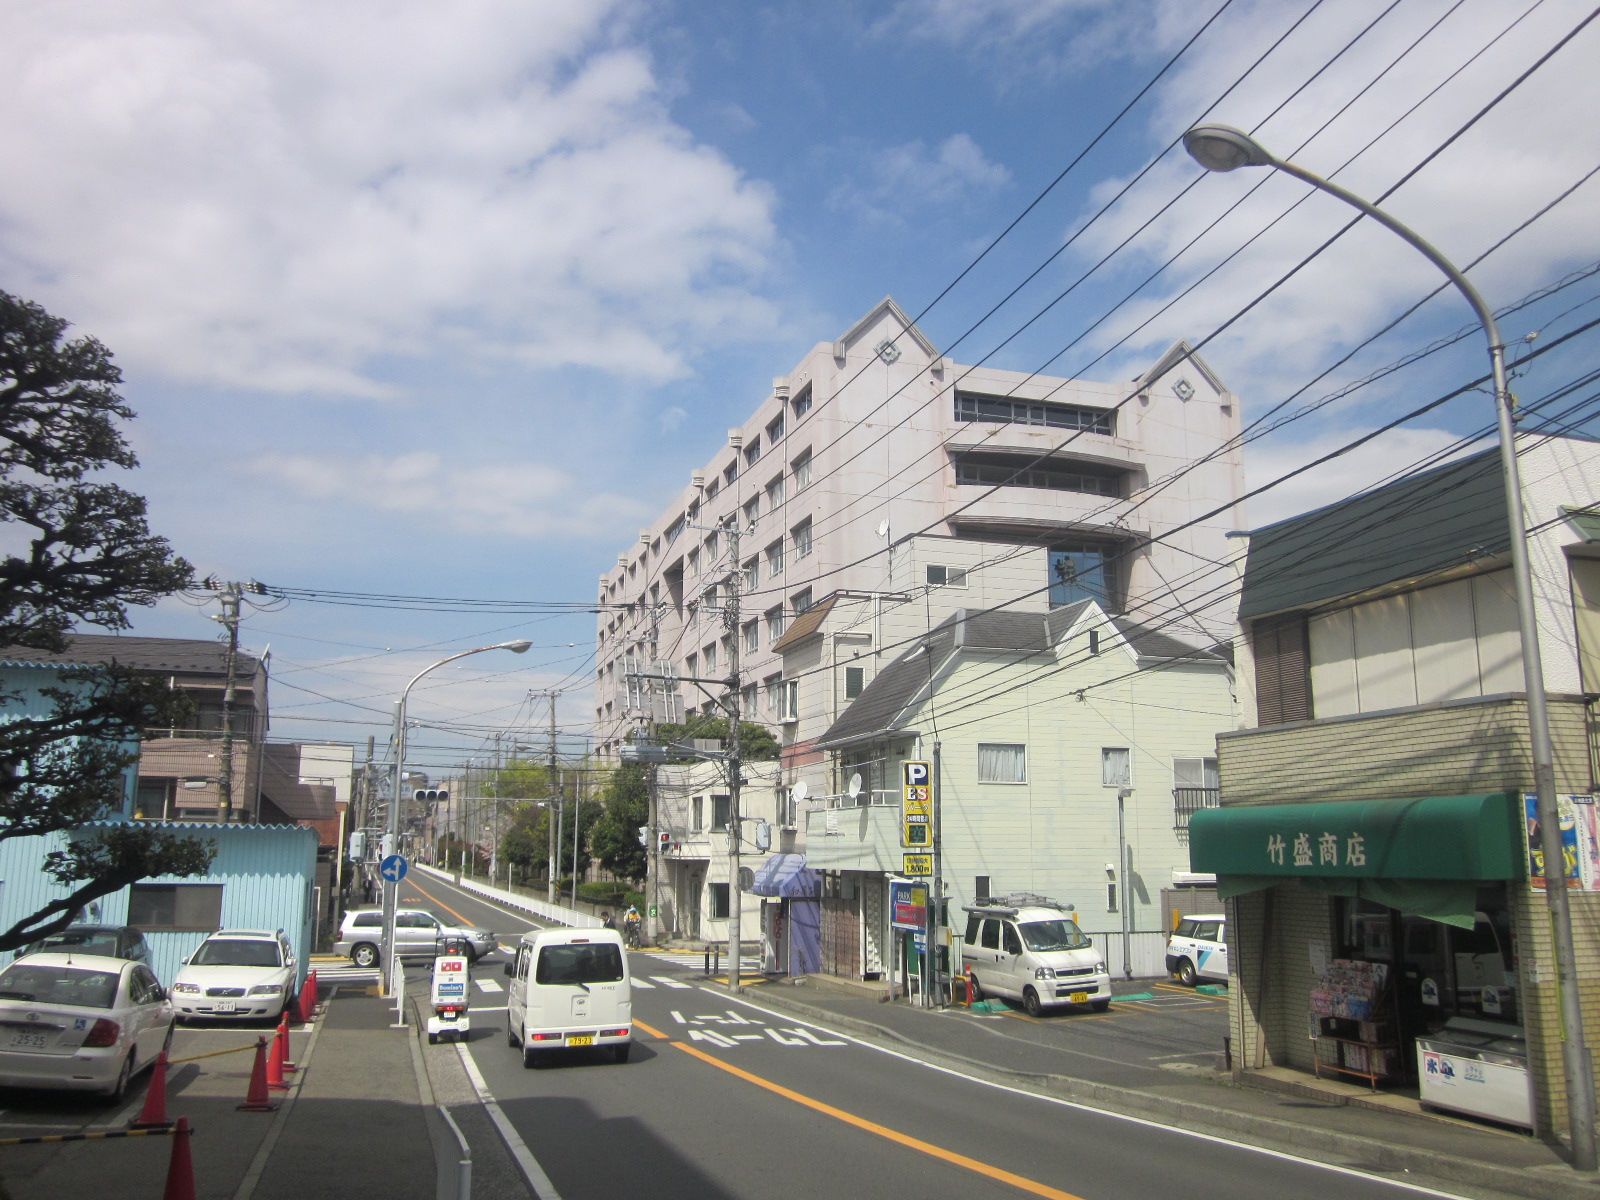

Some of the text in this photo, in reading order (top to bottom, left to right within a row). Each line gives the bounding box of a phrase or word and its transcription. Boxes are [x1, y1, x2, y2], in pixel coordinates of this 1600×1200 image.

[908, 764, 927, 785] P
[907, 787, 928, 800] ES
[1266, 831, 1367, 867] 竹盛商店
[687, 1028, 849, 1048] スクール
